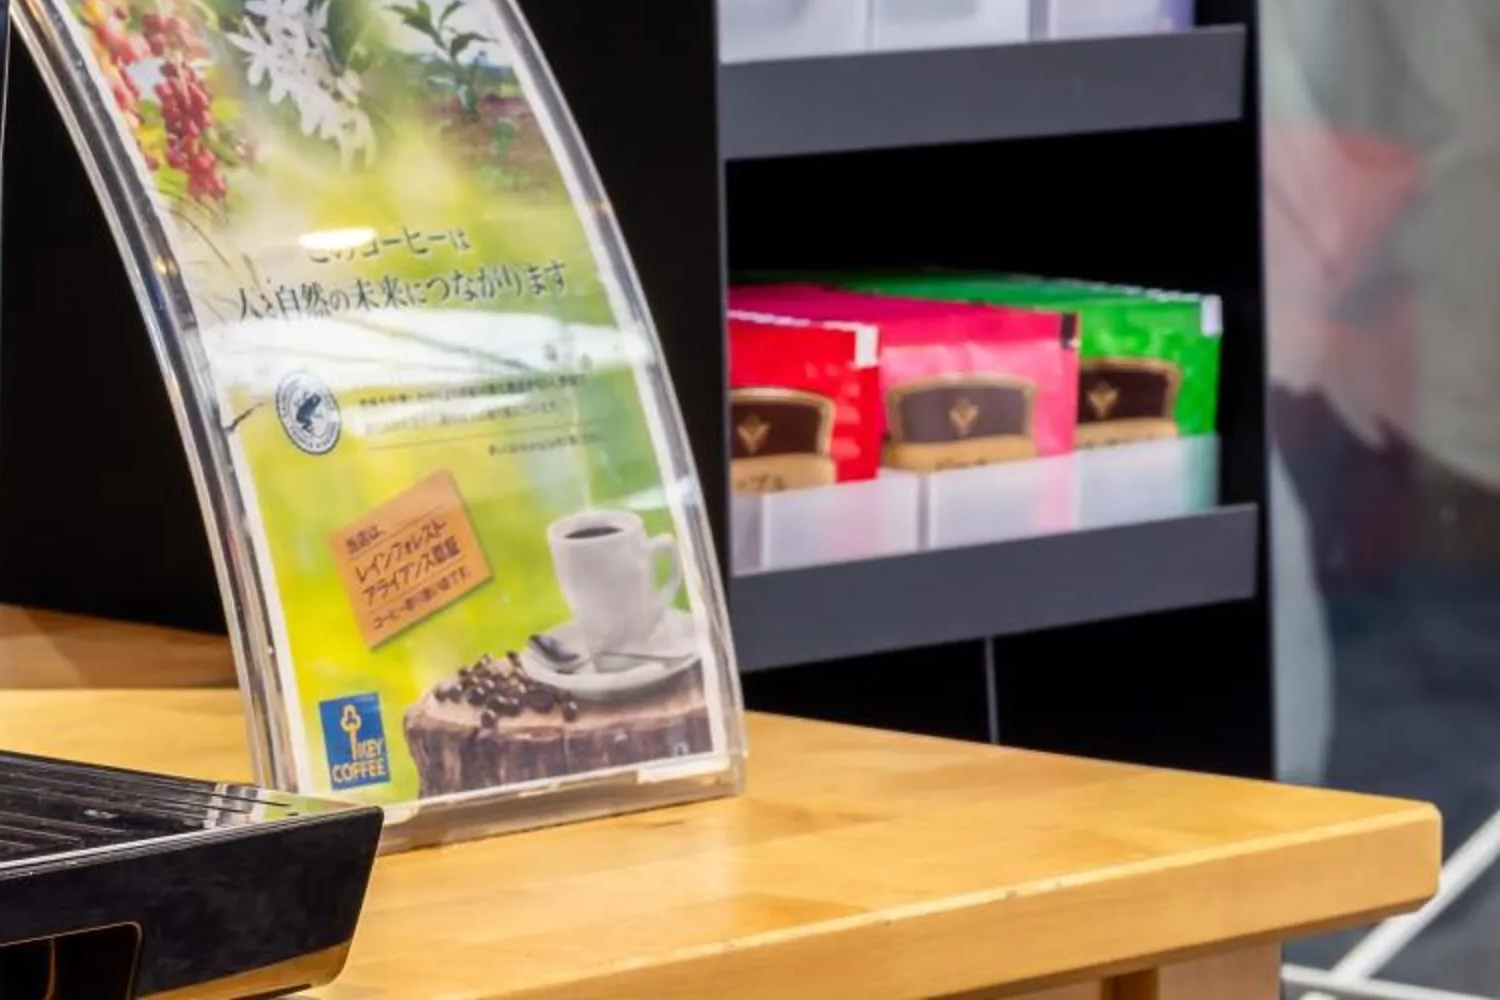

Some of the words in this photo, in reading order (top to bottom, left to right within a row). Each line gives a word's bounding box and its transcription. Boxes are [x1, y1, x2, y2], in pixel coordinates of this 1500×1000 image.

[238, 260, 566, 321] 人と自然の未来につながります
[355, 519, 449, 584] レインフォレスト
[355, 736, 385, 760] KEY
[331, 757, 387, 784] COFFEE
